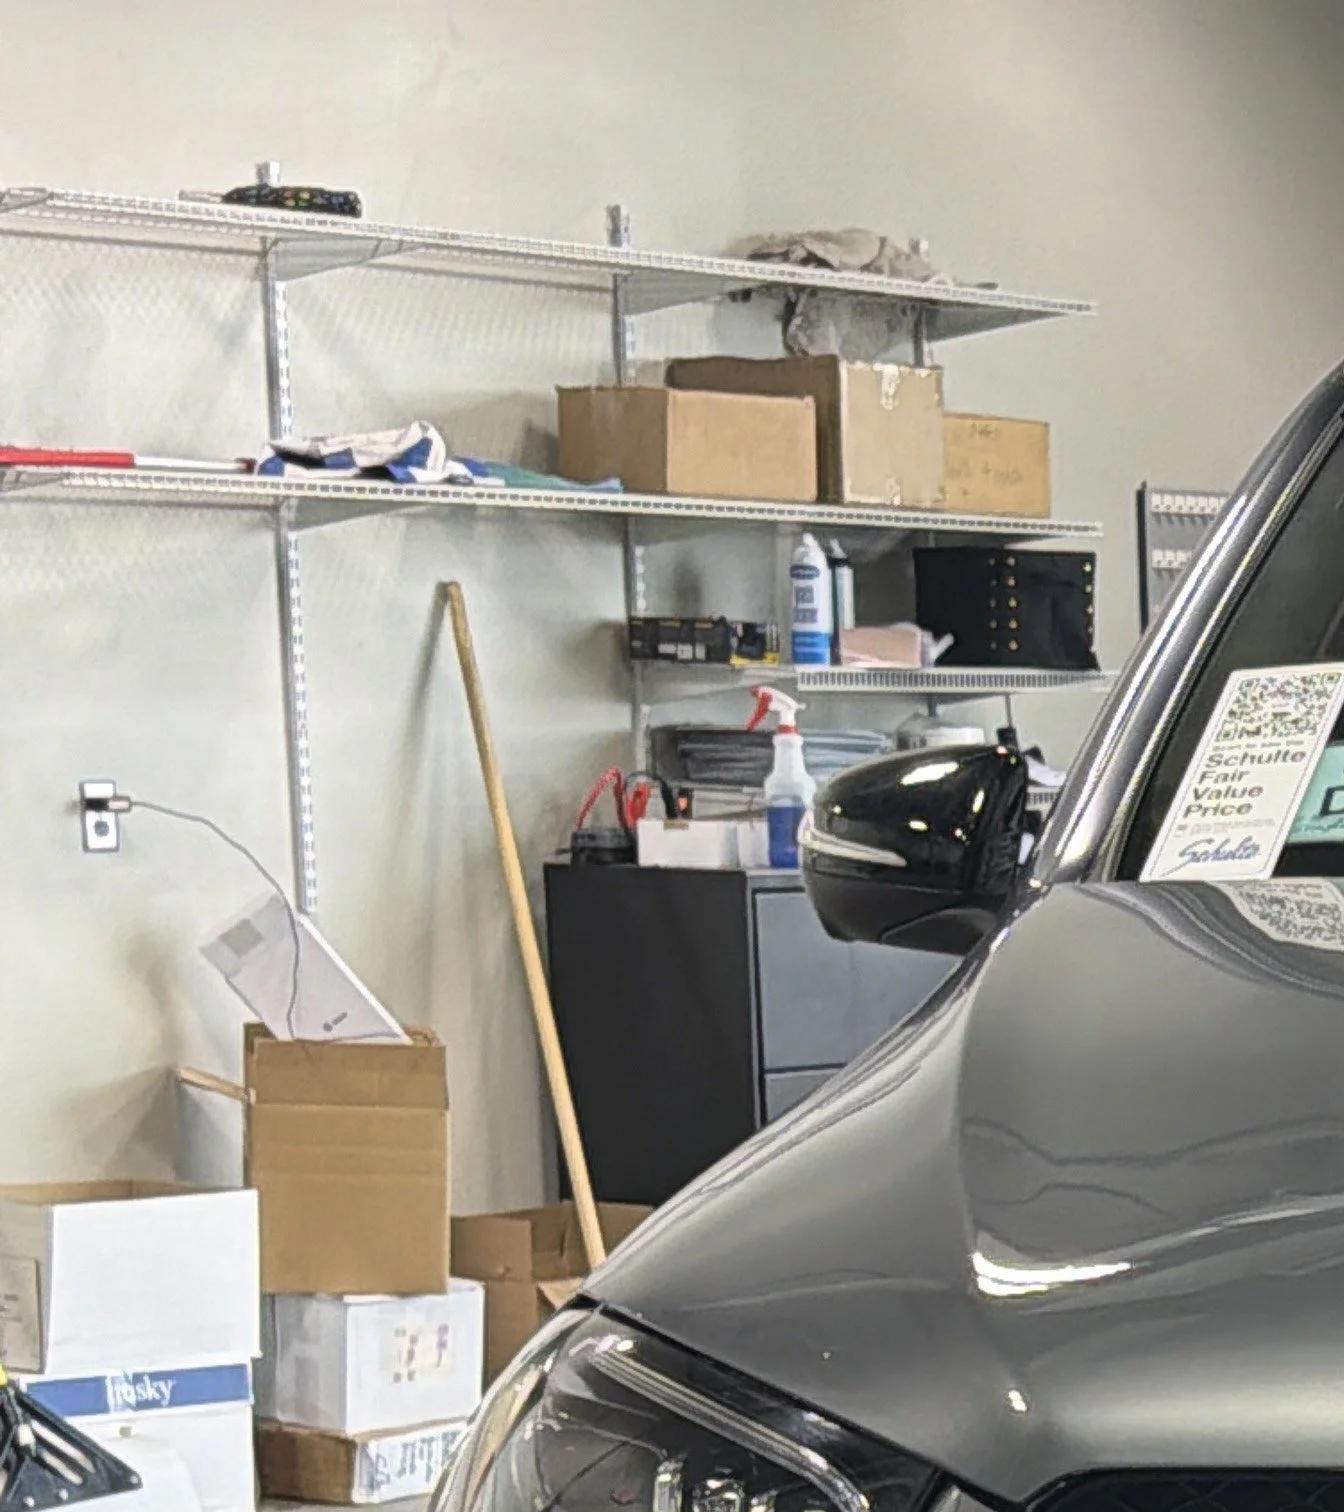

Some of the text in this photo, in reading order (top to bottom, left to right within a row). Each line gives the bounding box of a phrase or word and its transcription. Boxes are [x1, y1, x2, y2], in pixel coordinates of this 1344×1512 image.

[1205, 749, 1306, 769] Schulte
[1198, 768, 1250, 785] Fair
[1193, 785, 1264, 800] Value
[1183, 802, 1253, 818] Price
